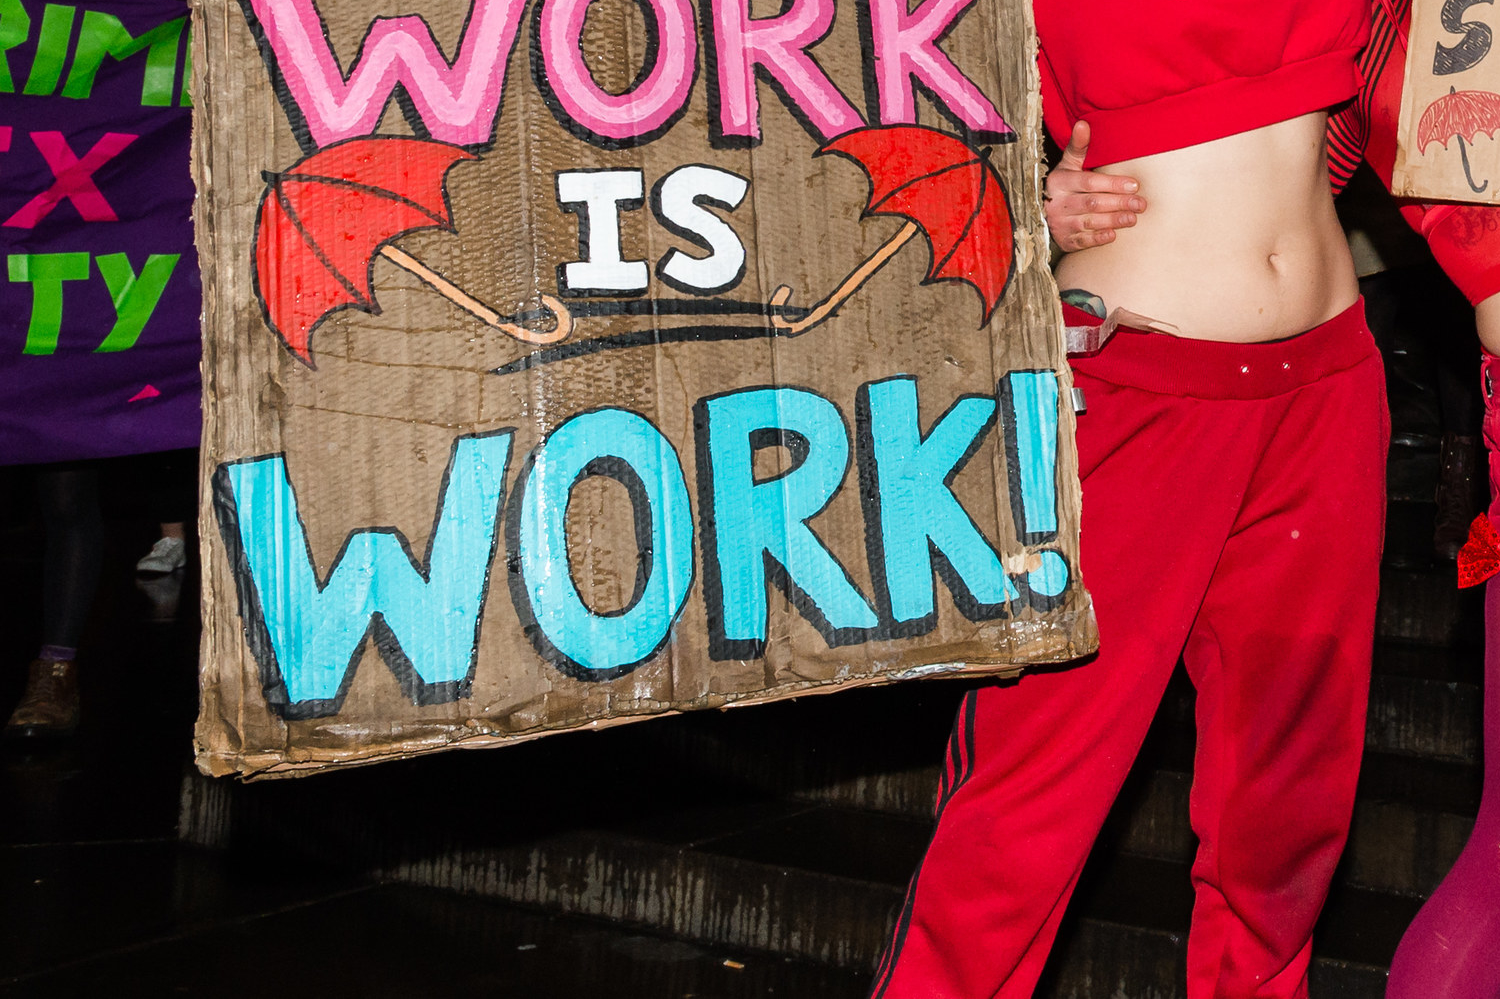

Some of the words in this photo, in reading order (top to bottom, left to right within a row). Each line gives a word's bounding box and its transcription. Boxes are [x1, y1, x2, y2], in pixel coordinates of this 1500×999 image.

[0, 124, 140, 230] X
[554, 163, 753, 298] IS
[216, 369, 1071, 721] WORK!
